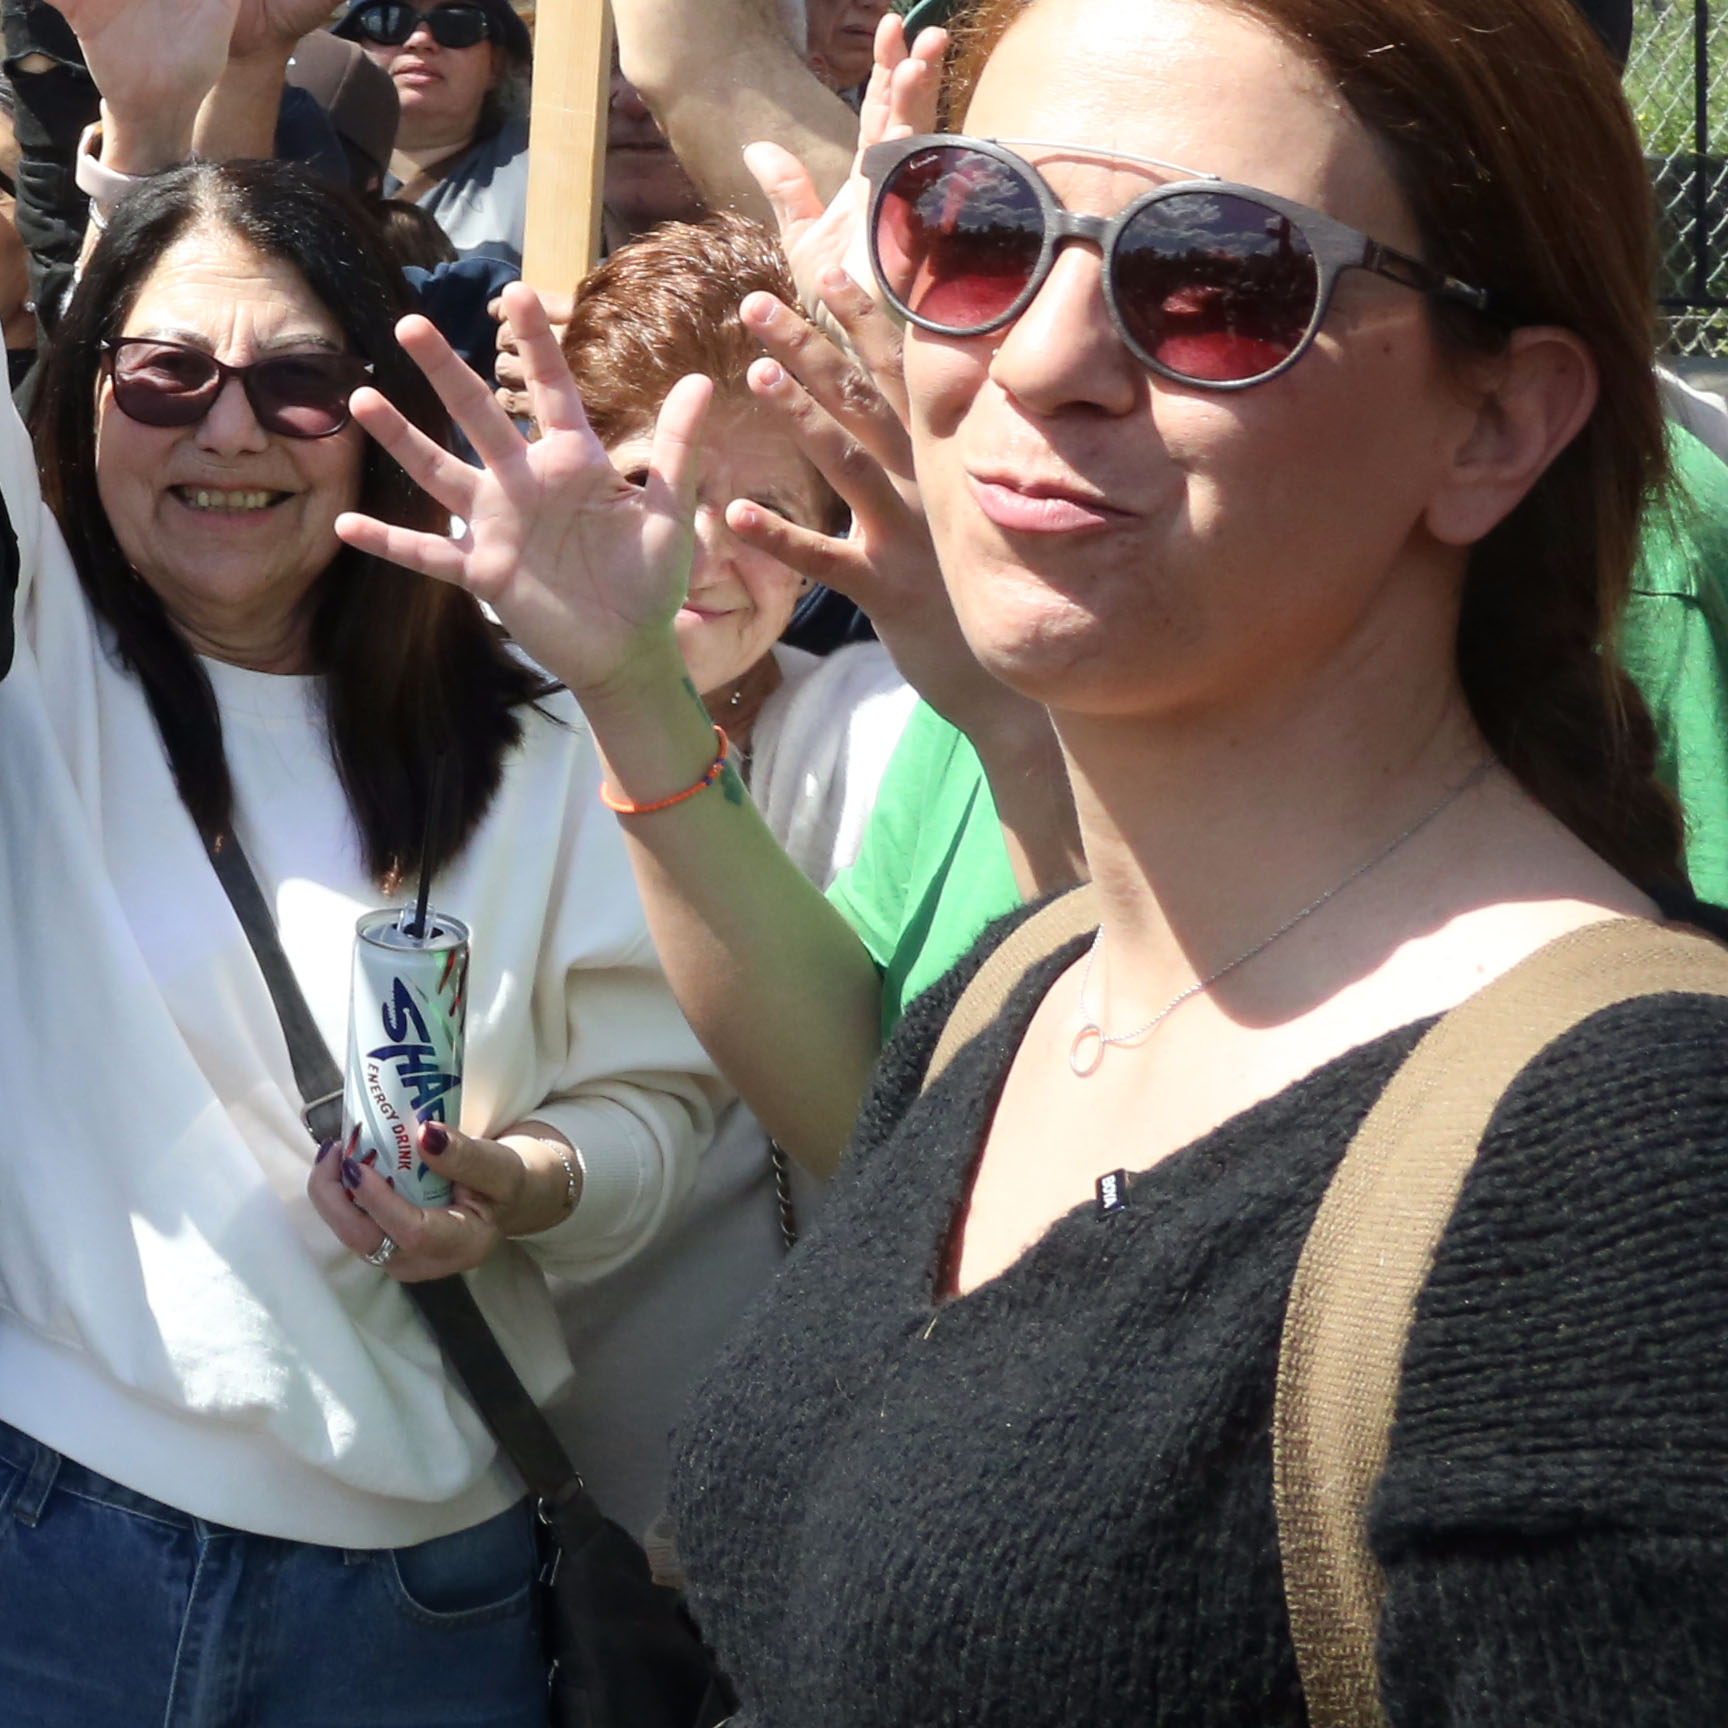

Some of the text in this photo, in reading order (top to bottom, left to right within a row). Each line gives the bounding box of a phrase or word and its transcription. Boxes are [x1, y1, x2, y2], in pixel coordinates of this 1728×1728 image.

[366, 976, 462, 1182] SHA
[367, 1062, 412, 1170] ENERGY DRINK
